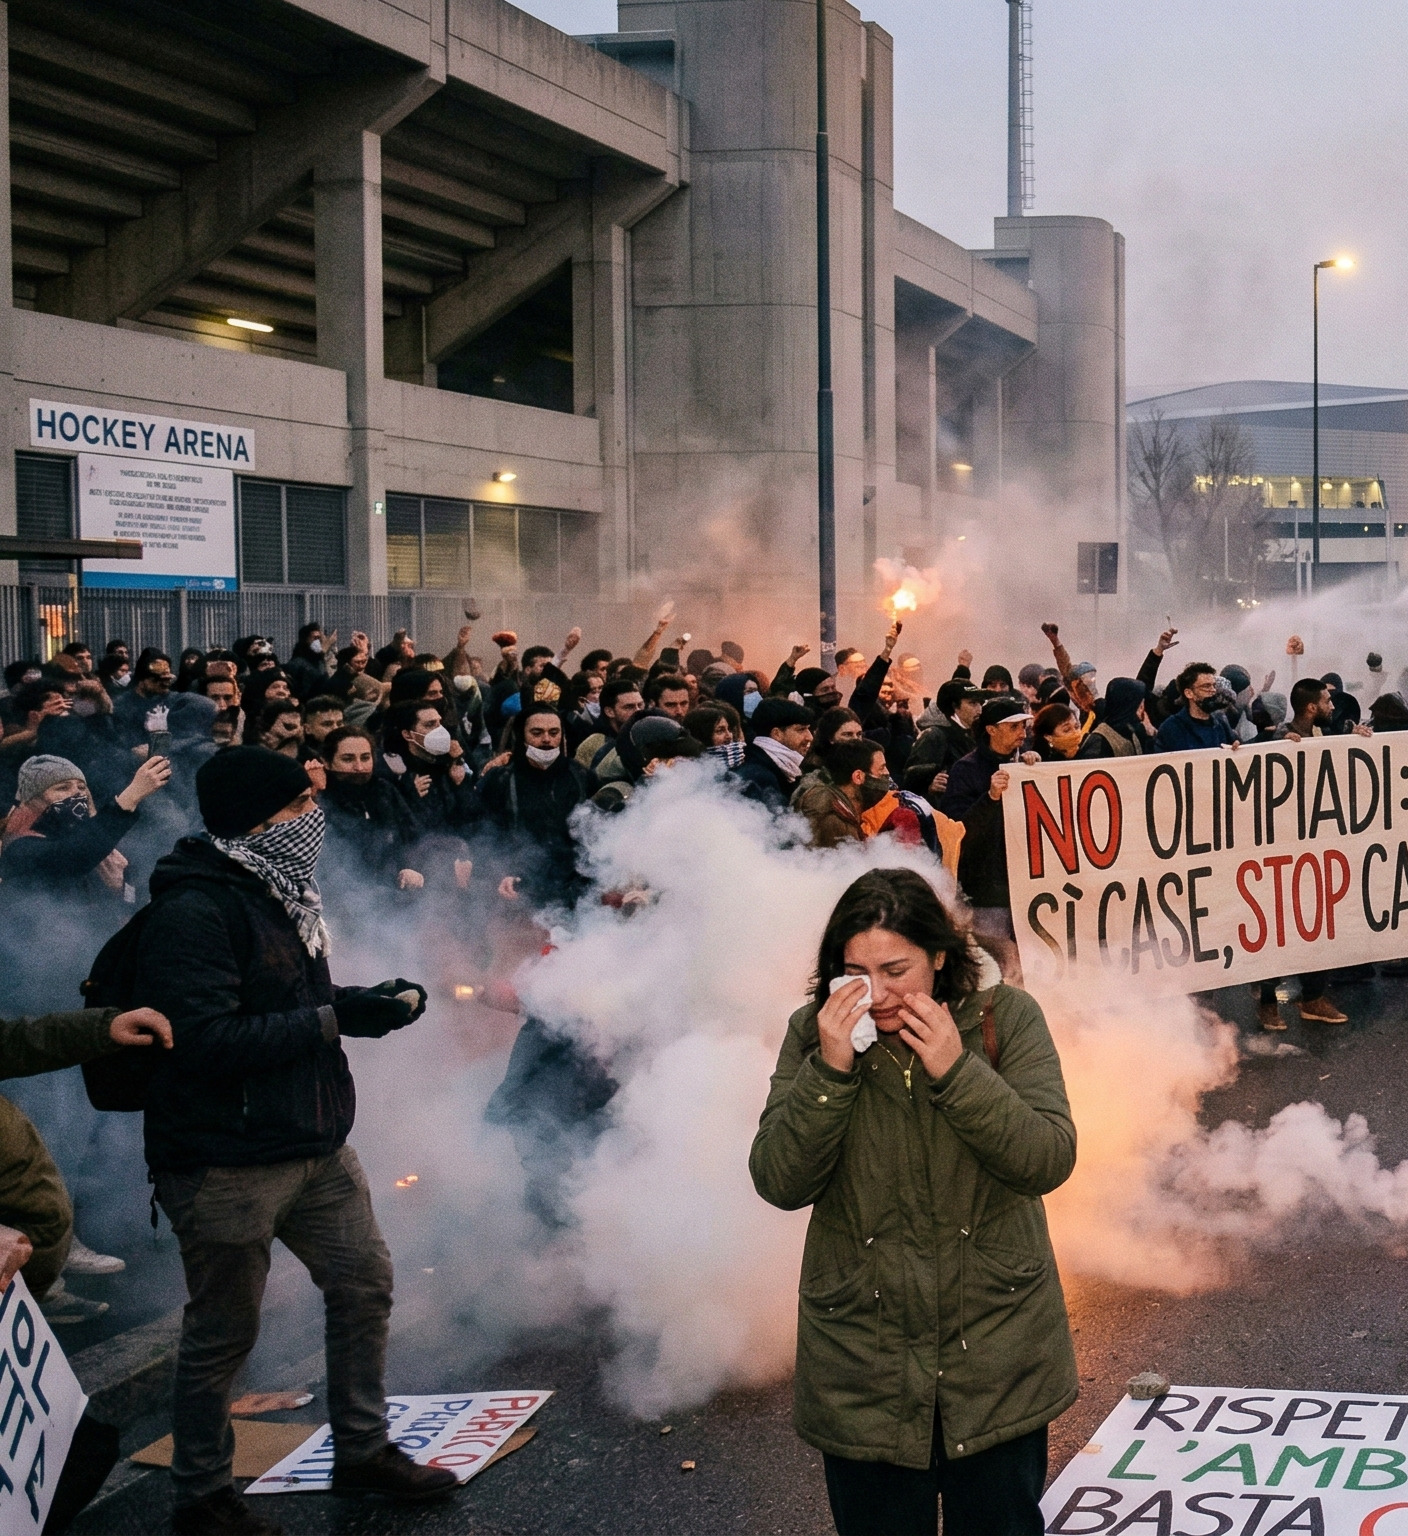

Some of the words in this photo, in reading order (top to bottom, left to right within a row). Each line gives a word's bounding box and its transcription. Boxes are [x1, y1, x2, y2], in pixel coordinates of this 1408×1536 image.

[36, 407, 156, 451] HOCKEY
[164, 426, 250, 463] ARENA
[1024, 769, 1122, 880] NO
[1027, 881, 1084, 983] SÌ
[1098, 866, 1234, 976] CASE,
[1236, 849, 1350, 954] STOP
[1043, 1486, 1325, 1536] BASTA
